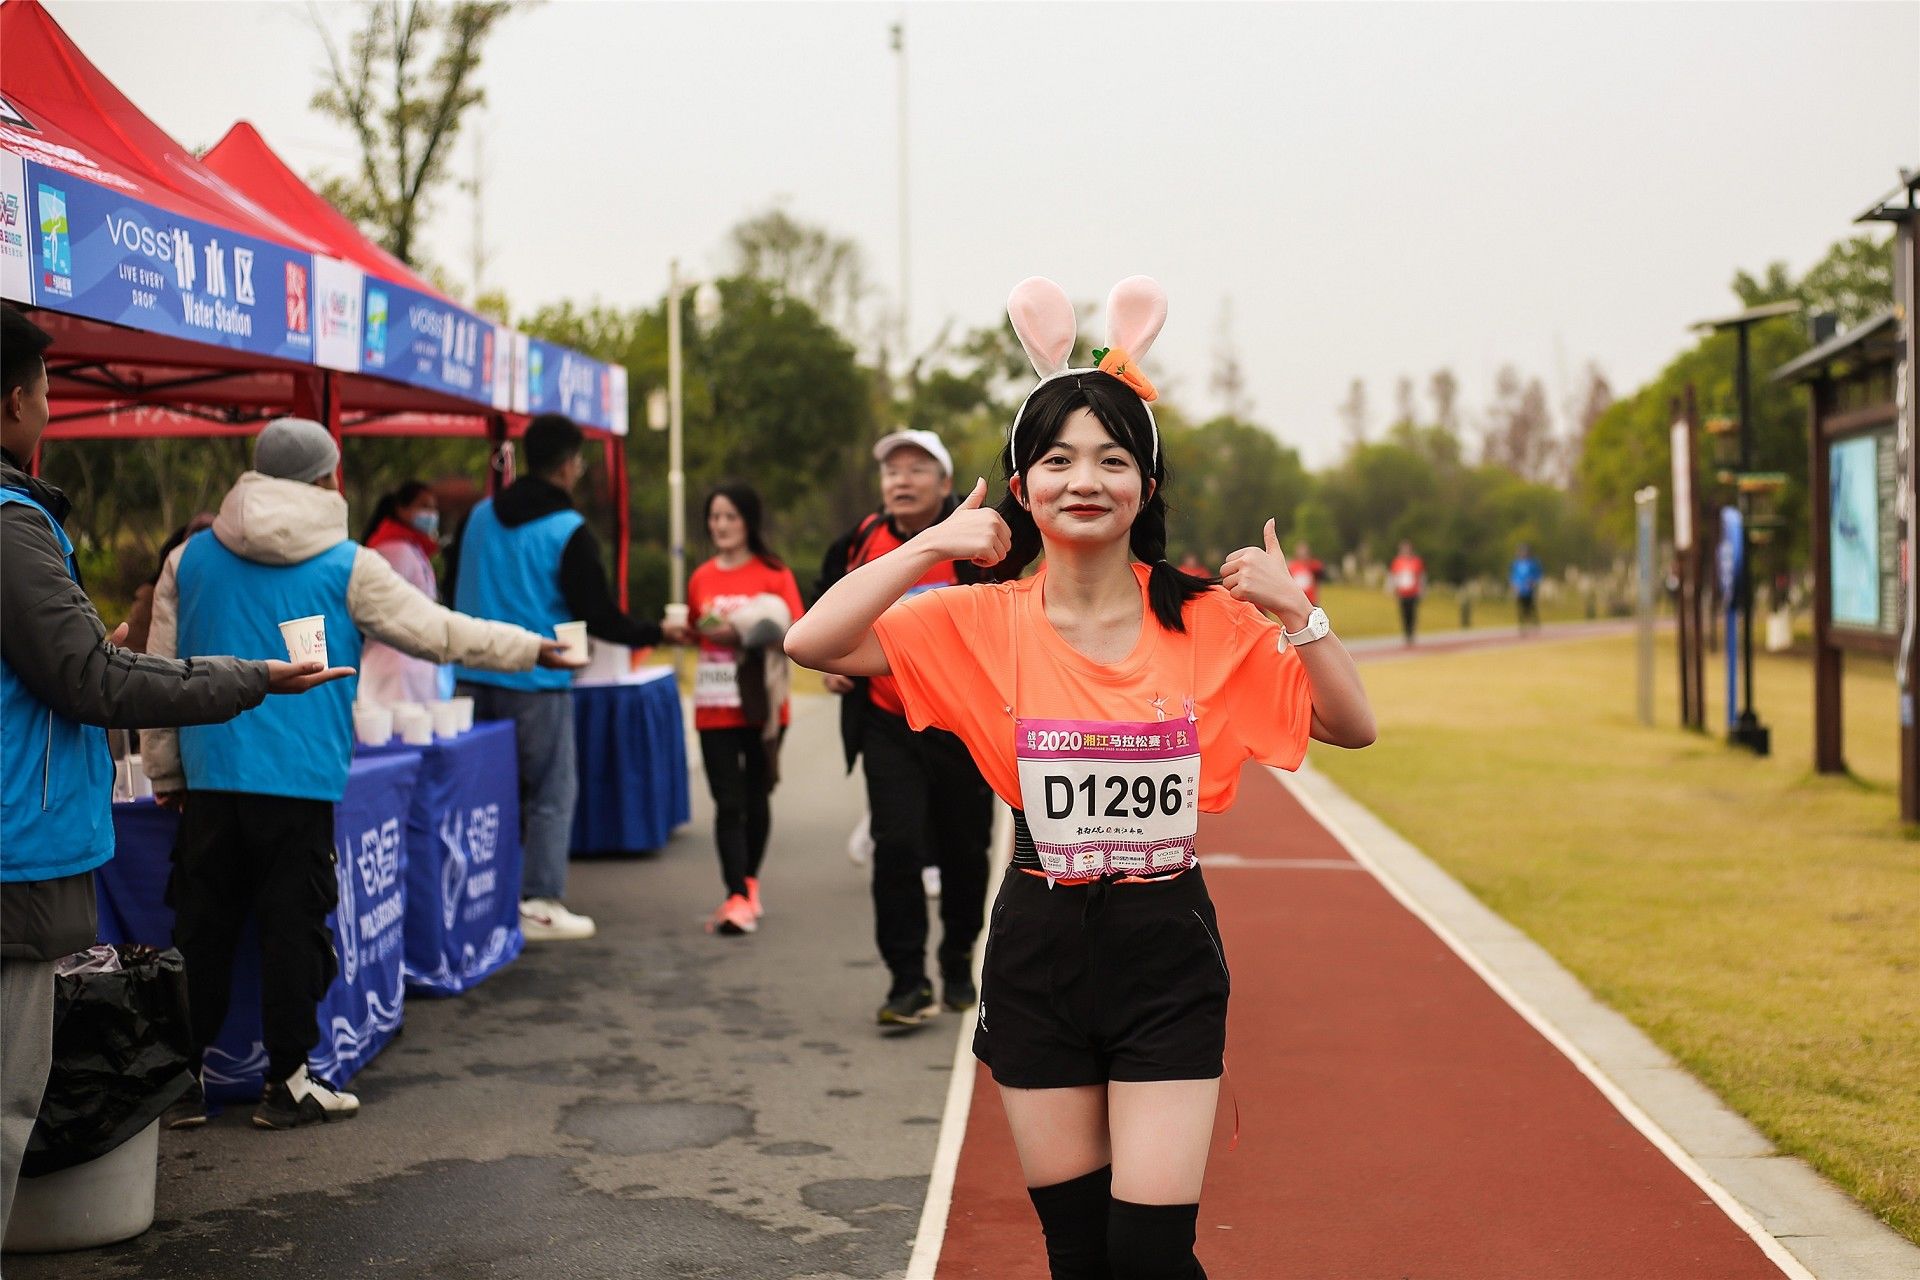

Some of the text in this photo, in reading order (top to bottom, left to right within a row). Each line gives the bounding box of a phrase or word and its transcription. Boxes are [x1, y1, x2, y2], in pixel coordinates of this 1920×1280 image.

[106, 213, 172, 262] VOSS
[119, 263, 165, 290] LIVE EVERY
[182, 291, 253, 337] Water Station
[1044, 774, 1182, 820] D1296
